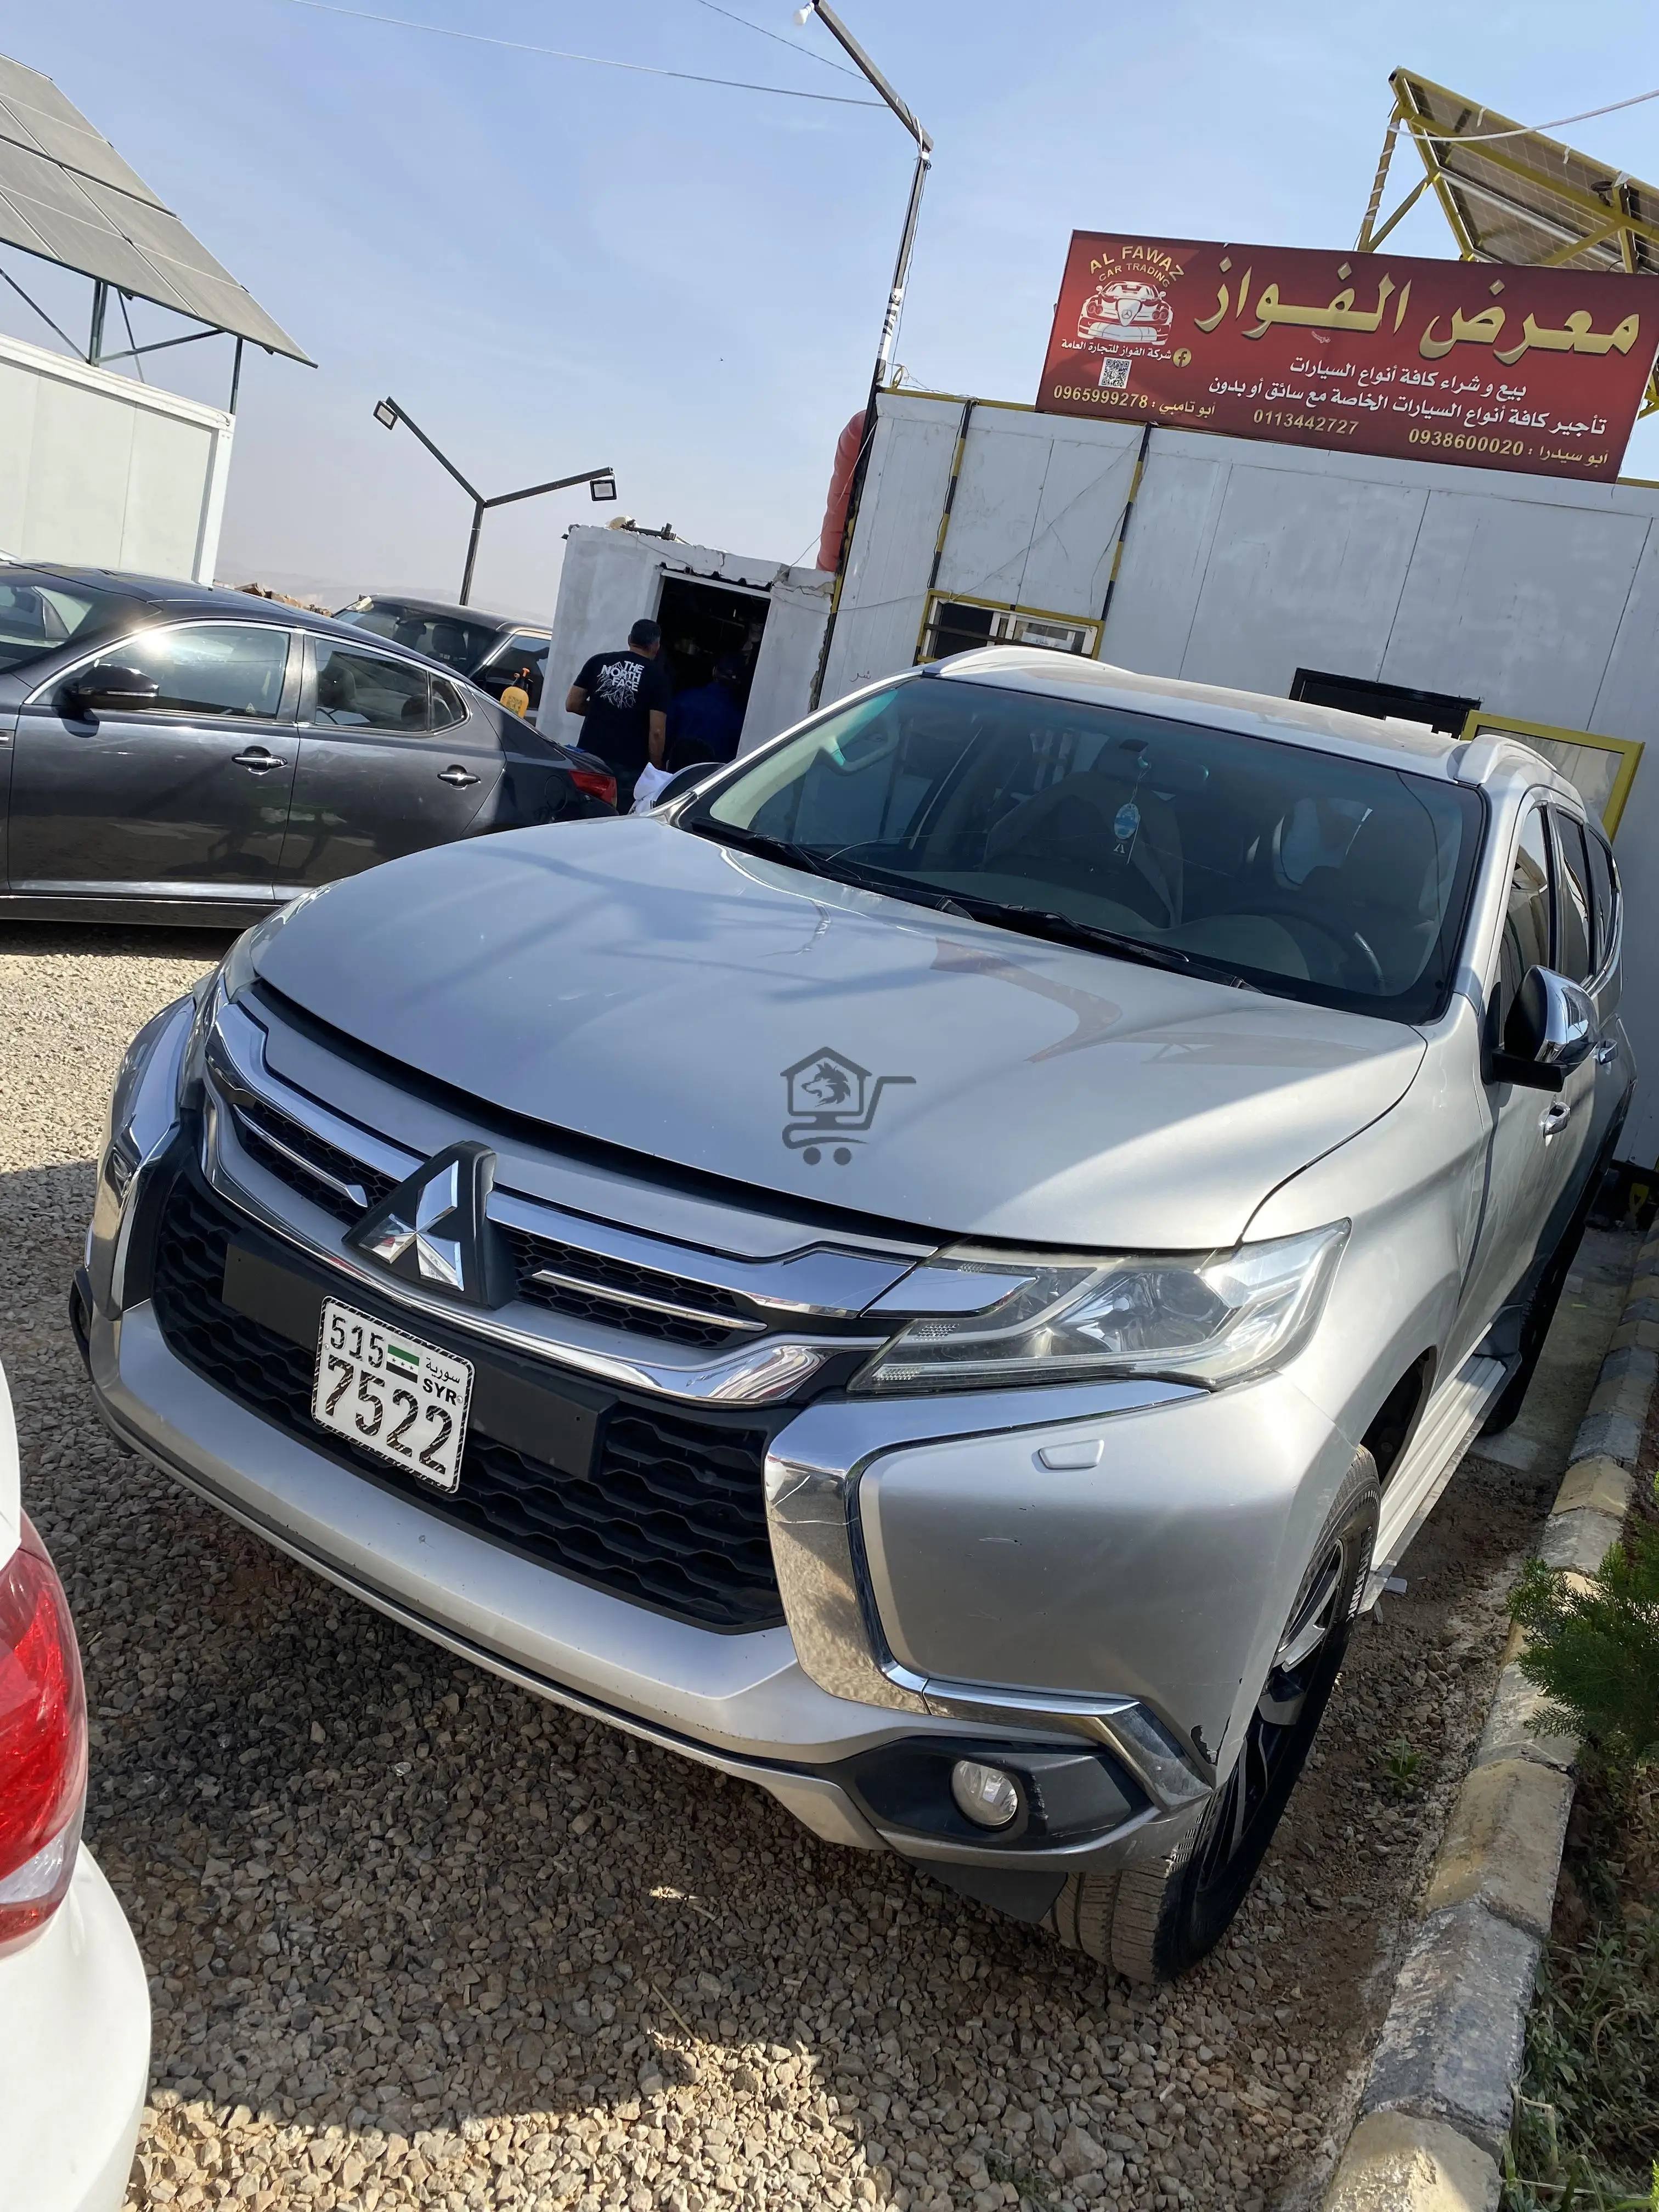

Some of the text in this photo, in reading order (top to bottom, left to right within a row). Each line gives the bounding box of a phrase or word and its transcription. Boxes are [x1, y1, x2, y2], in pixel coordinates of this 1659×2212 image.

[1090, 246, 1184, 281] AL FAWAZ
[1099, 263, 1170, 287] CAR TRADING
[1194, 256, 1639, 365] معرض الفواز
[1061, 338, 1172, 360] شركة الفواز للتجارة العامة
[1290, 357, 1527, 402] بيع و شراء كافة أنواع السيارات
[1053, 385, 1149, 409] 0965999278
[1208, 376, 1607, 437] تأجير كافة أنواع السيارات الخاصة مع سائق أو بدون
[1195, 402, 1216, 419] أبو
[1254, 409, 1359, 435] 0113442727
[1408, 428, 1525, 456] 0938600020
[1538, 445, 1583, 464] سيدرا
[1583, 449, 1610, 467] أبو
[600, 664, 641, 682] NORTH
[624, 661, 645, 675] THE
[612, 676, 639, 692] FACE
[330, 1314, 386, 1369] 515
[425, 1357, 461, 1384] سورية
[422, 1378, 458, 1407] SYR
[325, 1354, 453, 1475] 7522
